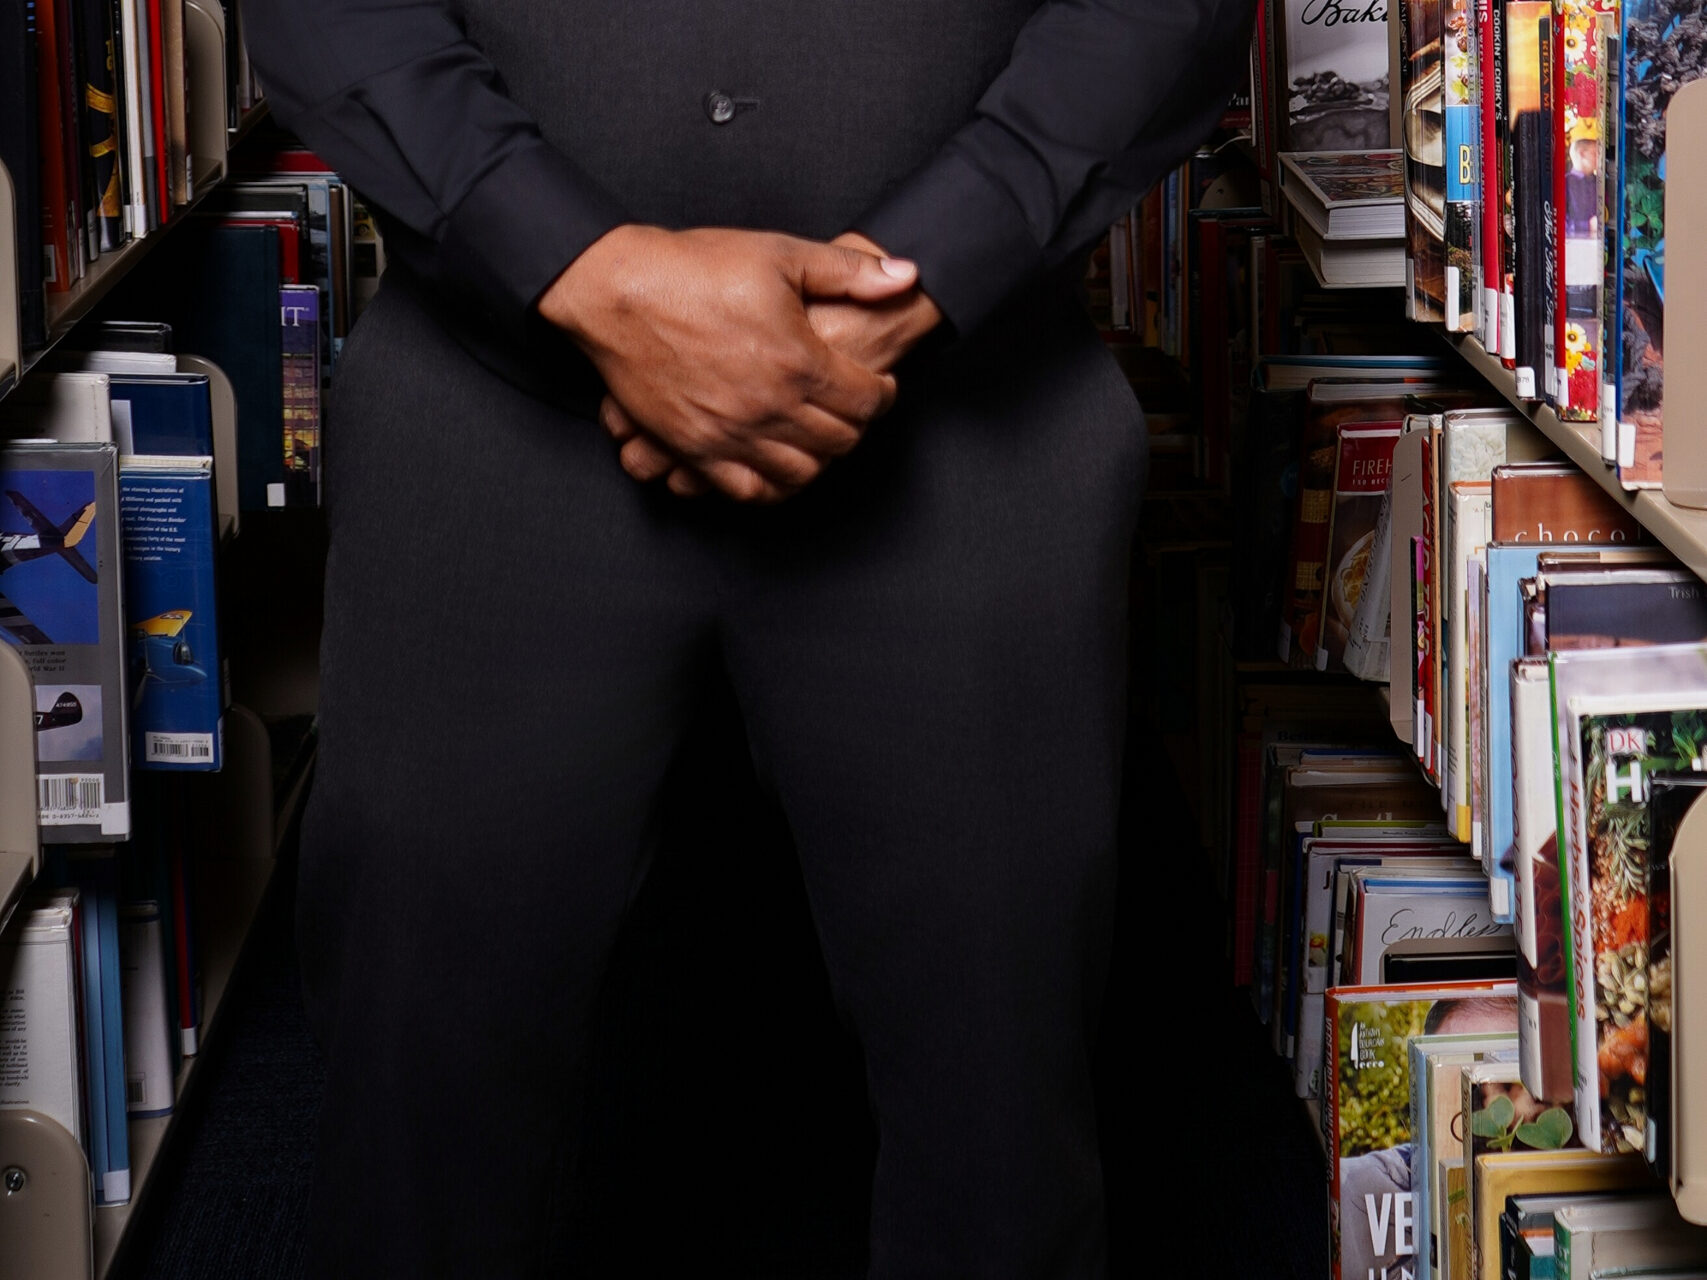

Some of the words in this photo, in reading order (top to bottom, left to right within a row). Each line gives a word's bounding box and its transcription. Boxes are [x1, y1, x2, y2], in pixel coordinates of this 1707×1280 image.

[1544, 200, 1554, 244] Not
[1545, 248, 1554, 293] That
[1610, 730, 1642, 752] DK
[1570, 779, 1582, 884] Herbs
[1574, 904, 1588, 1022] Spices
